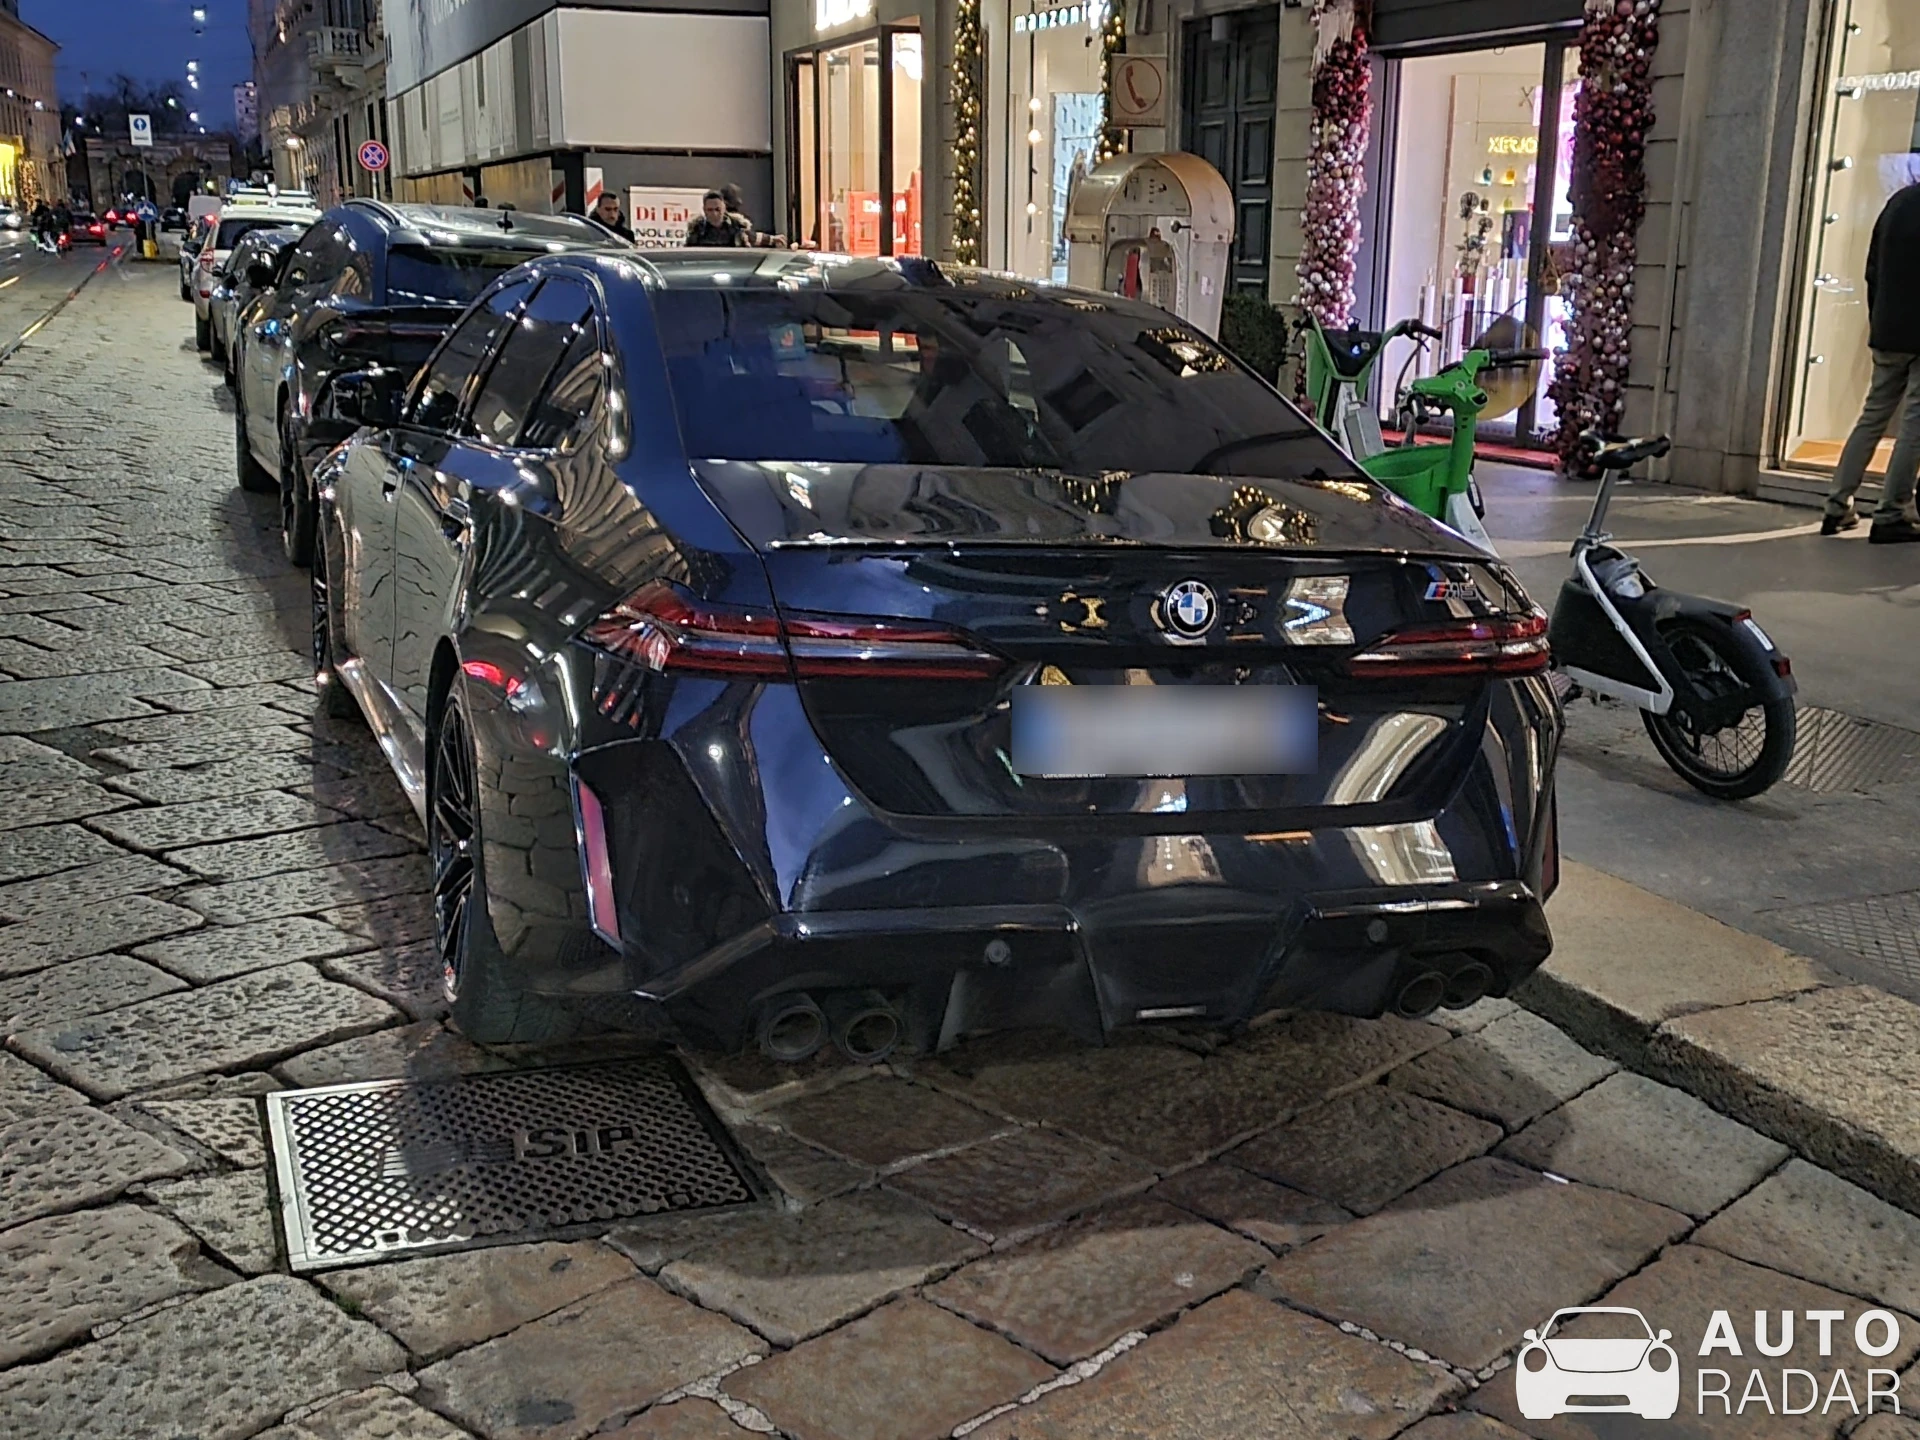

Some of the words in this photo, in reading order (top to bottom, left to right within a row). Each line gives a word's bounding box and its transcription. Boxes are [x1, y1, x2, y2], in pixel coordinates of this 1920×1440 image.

[1015, 1, 1087, 33] manzoni
[636, 206, 656, 221] Di
[1171, 583, 1213, 601] BMW
[522, 1126, 634, 1158] SIP
